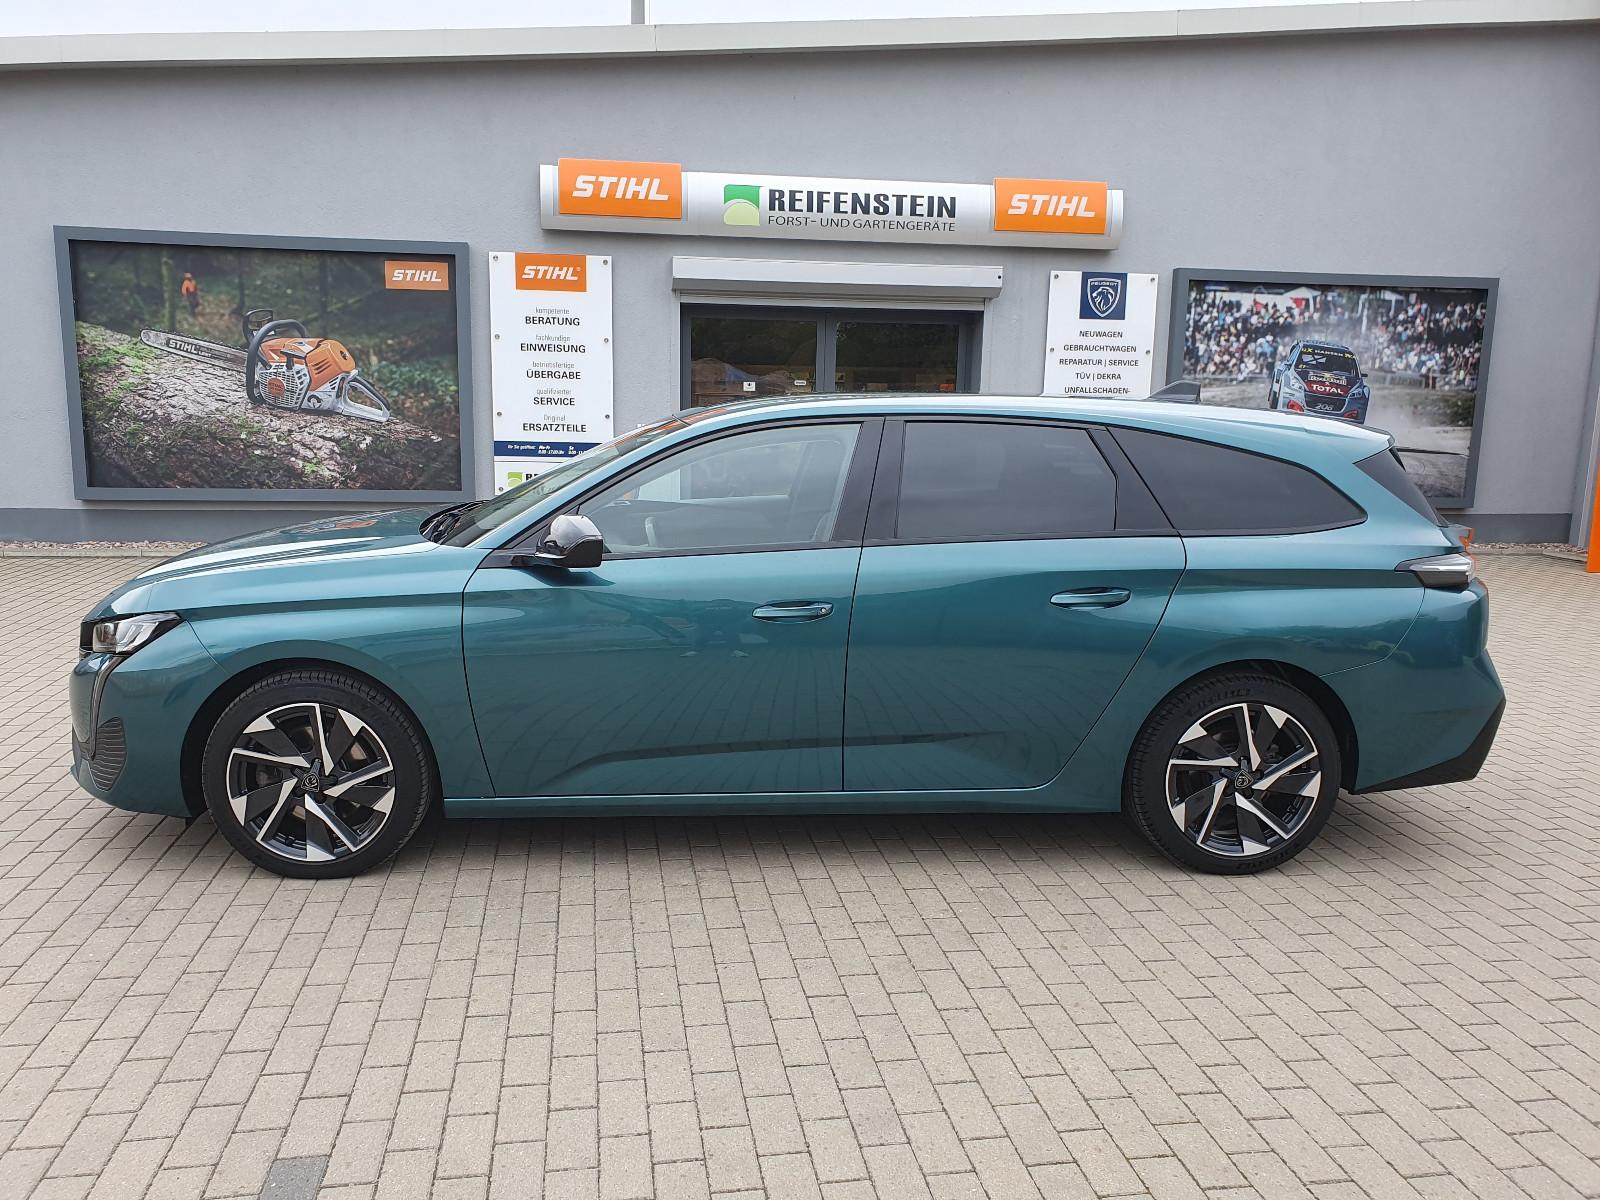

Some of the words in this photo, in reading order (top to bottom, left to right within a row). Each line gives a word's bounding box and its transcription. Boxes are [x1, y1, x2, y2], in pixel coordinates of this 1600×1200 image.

[571, 175, 669, 201] STIHL
[768, 188, 957, 219] REIFENSTEIN
[1007, 193, 1096, 218] STIHL
[768, 215, 817, 227] FORST-
[820, 217, 850, 229] UND
[852, 218, 956, 232] GARTENGERÄTE
[391, 269, 442, 283] STIHL
[521, 265, 579, 281] STIHL
[525, 315, 580, 326] BERATUNG
[1078, 330, 1123, 338] NEUWAGEN
[168, 339, 198, 354] STIHL
[520, 343, 586, 354] EINWEISUNG
[1063, 344, 1137, 353] GEBRAUCHTWAGEN
[1059, 358, 1103, 366] REPARATUR
[1108, 359, 1139, 367] SERVICE
[526, 368, 582, 380] ÜBERGABE
[1075, 371, 1091, 380] TÜV
[1064, 386, 1131, 395] UNFALLSCHADEN-
[1311, 384, 1344, 394] TOTAL
[533, 396, 575, 406] SERVICE
[522, 422, 587, 433] ERSATZTEILE
